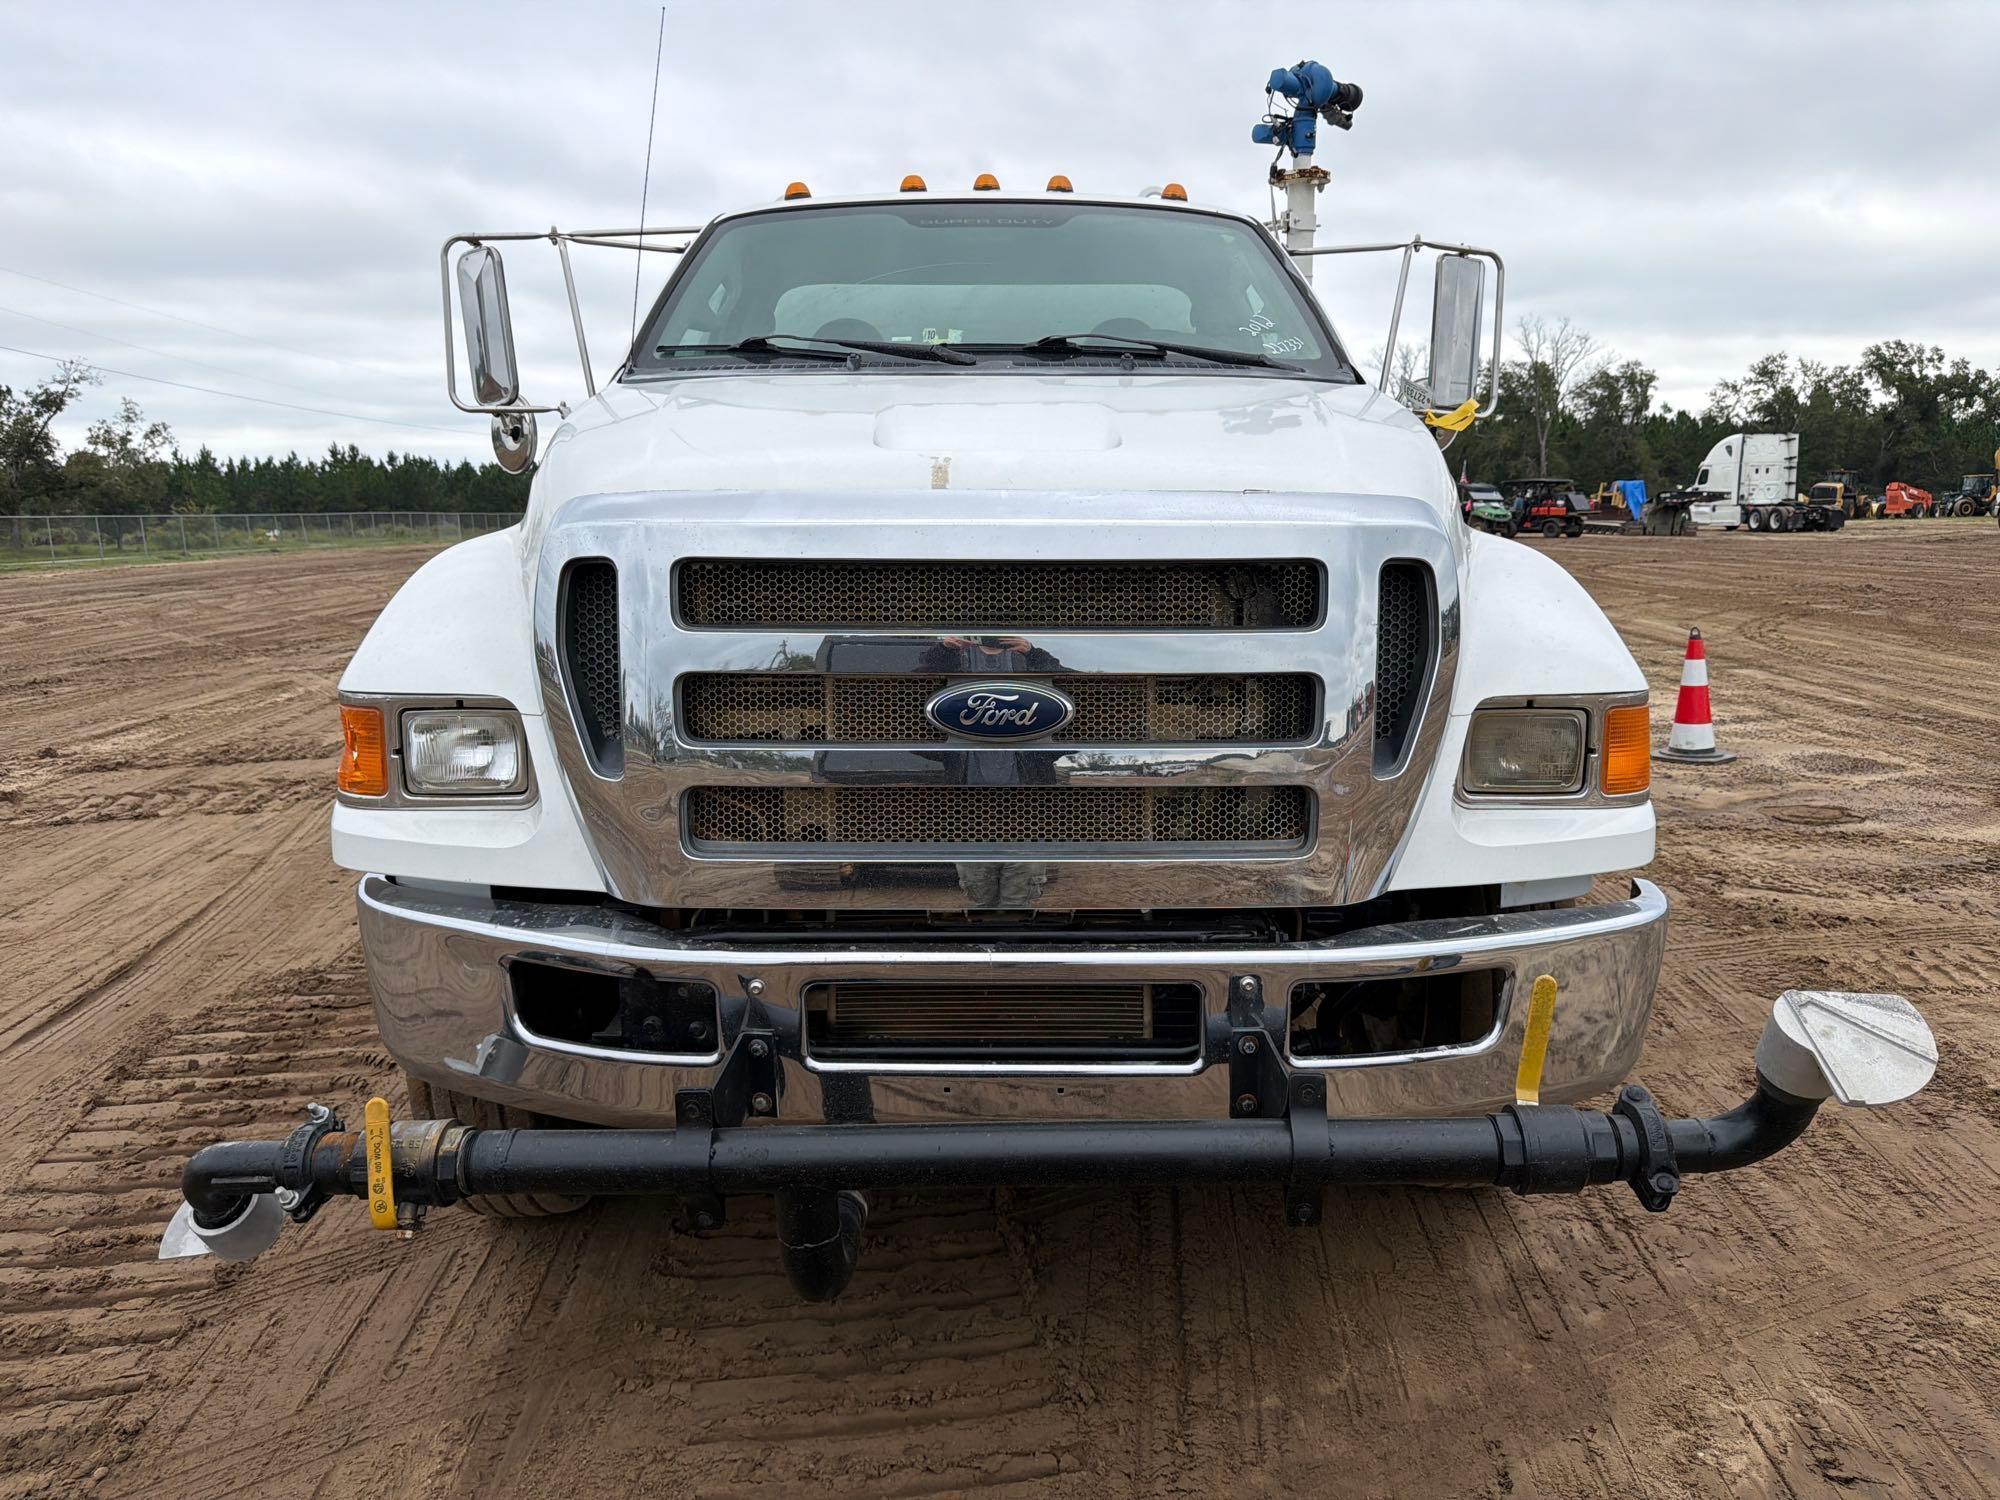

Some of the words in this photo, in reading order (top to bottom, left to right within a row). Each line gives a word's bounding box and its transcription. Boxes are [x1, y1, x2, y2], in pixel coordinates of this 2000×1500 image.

[919, 217, 990, 225] SUPER
[997, 217, 1054, 225] DUTY
[1238, 314, 1276, 337] 2012
[1262, 336, 1304, 354] 227331
[959, 693, 1039, 726] Ford
